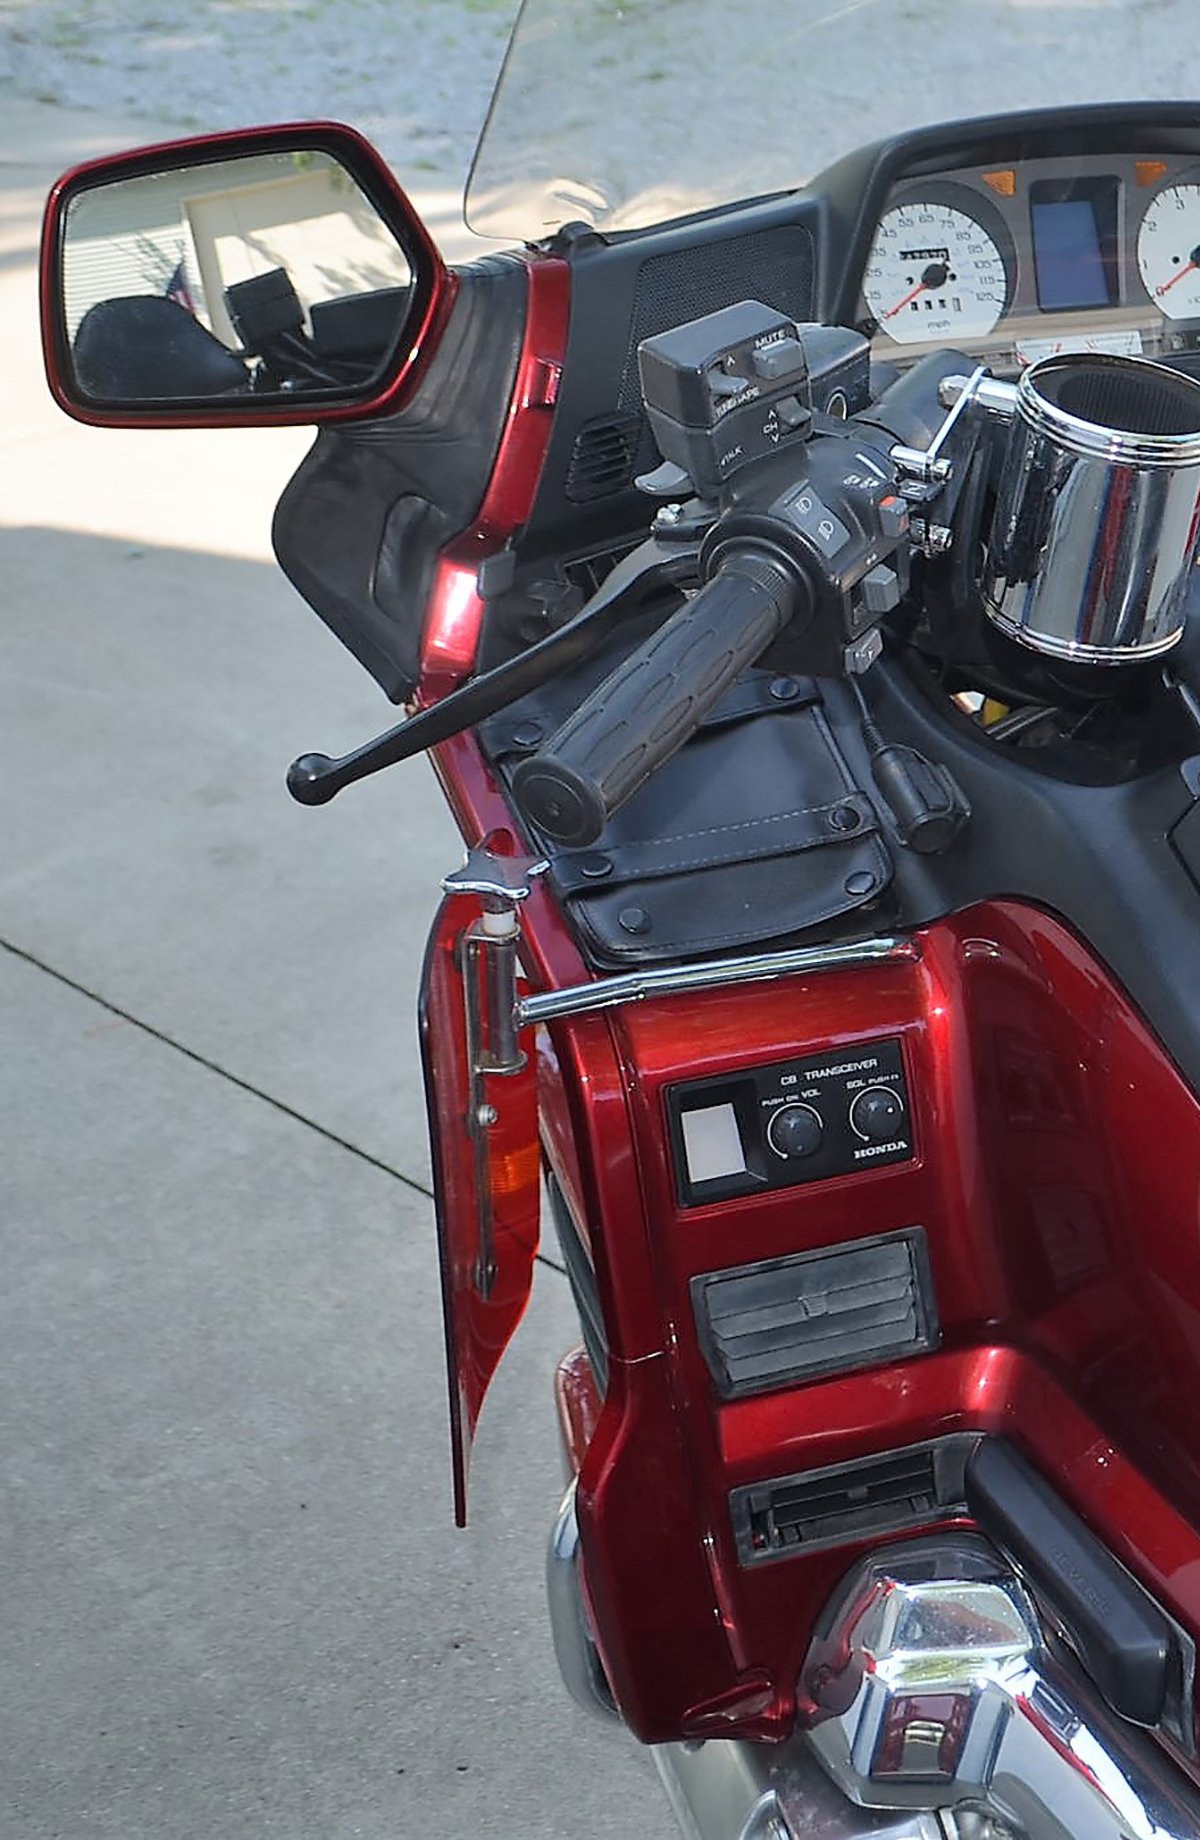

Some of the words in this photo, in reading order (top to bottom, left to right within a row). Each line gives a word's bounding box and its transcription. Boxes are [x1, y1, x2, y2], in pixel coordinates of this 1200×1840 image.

[755, 328, 787, 350] MUTE
[763, 420, 779, 434] CH
[780, 1074, 798, 1086] CB
[804, 1057, 878, 1081] TRANSCEIVER
[761, 1097, 785, 1107] PUSH
[801, 1088, 822, 1099] VOL
[853, 1140, 908, 1160] HONDA
